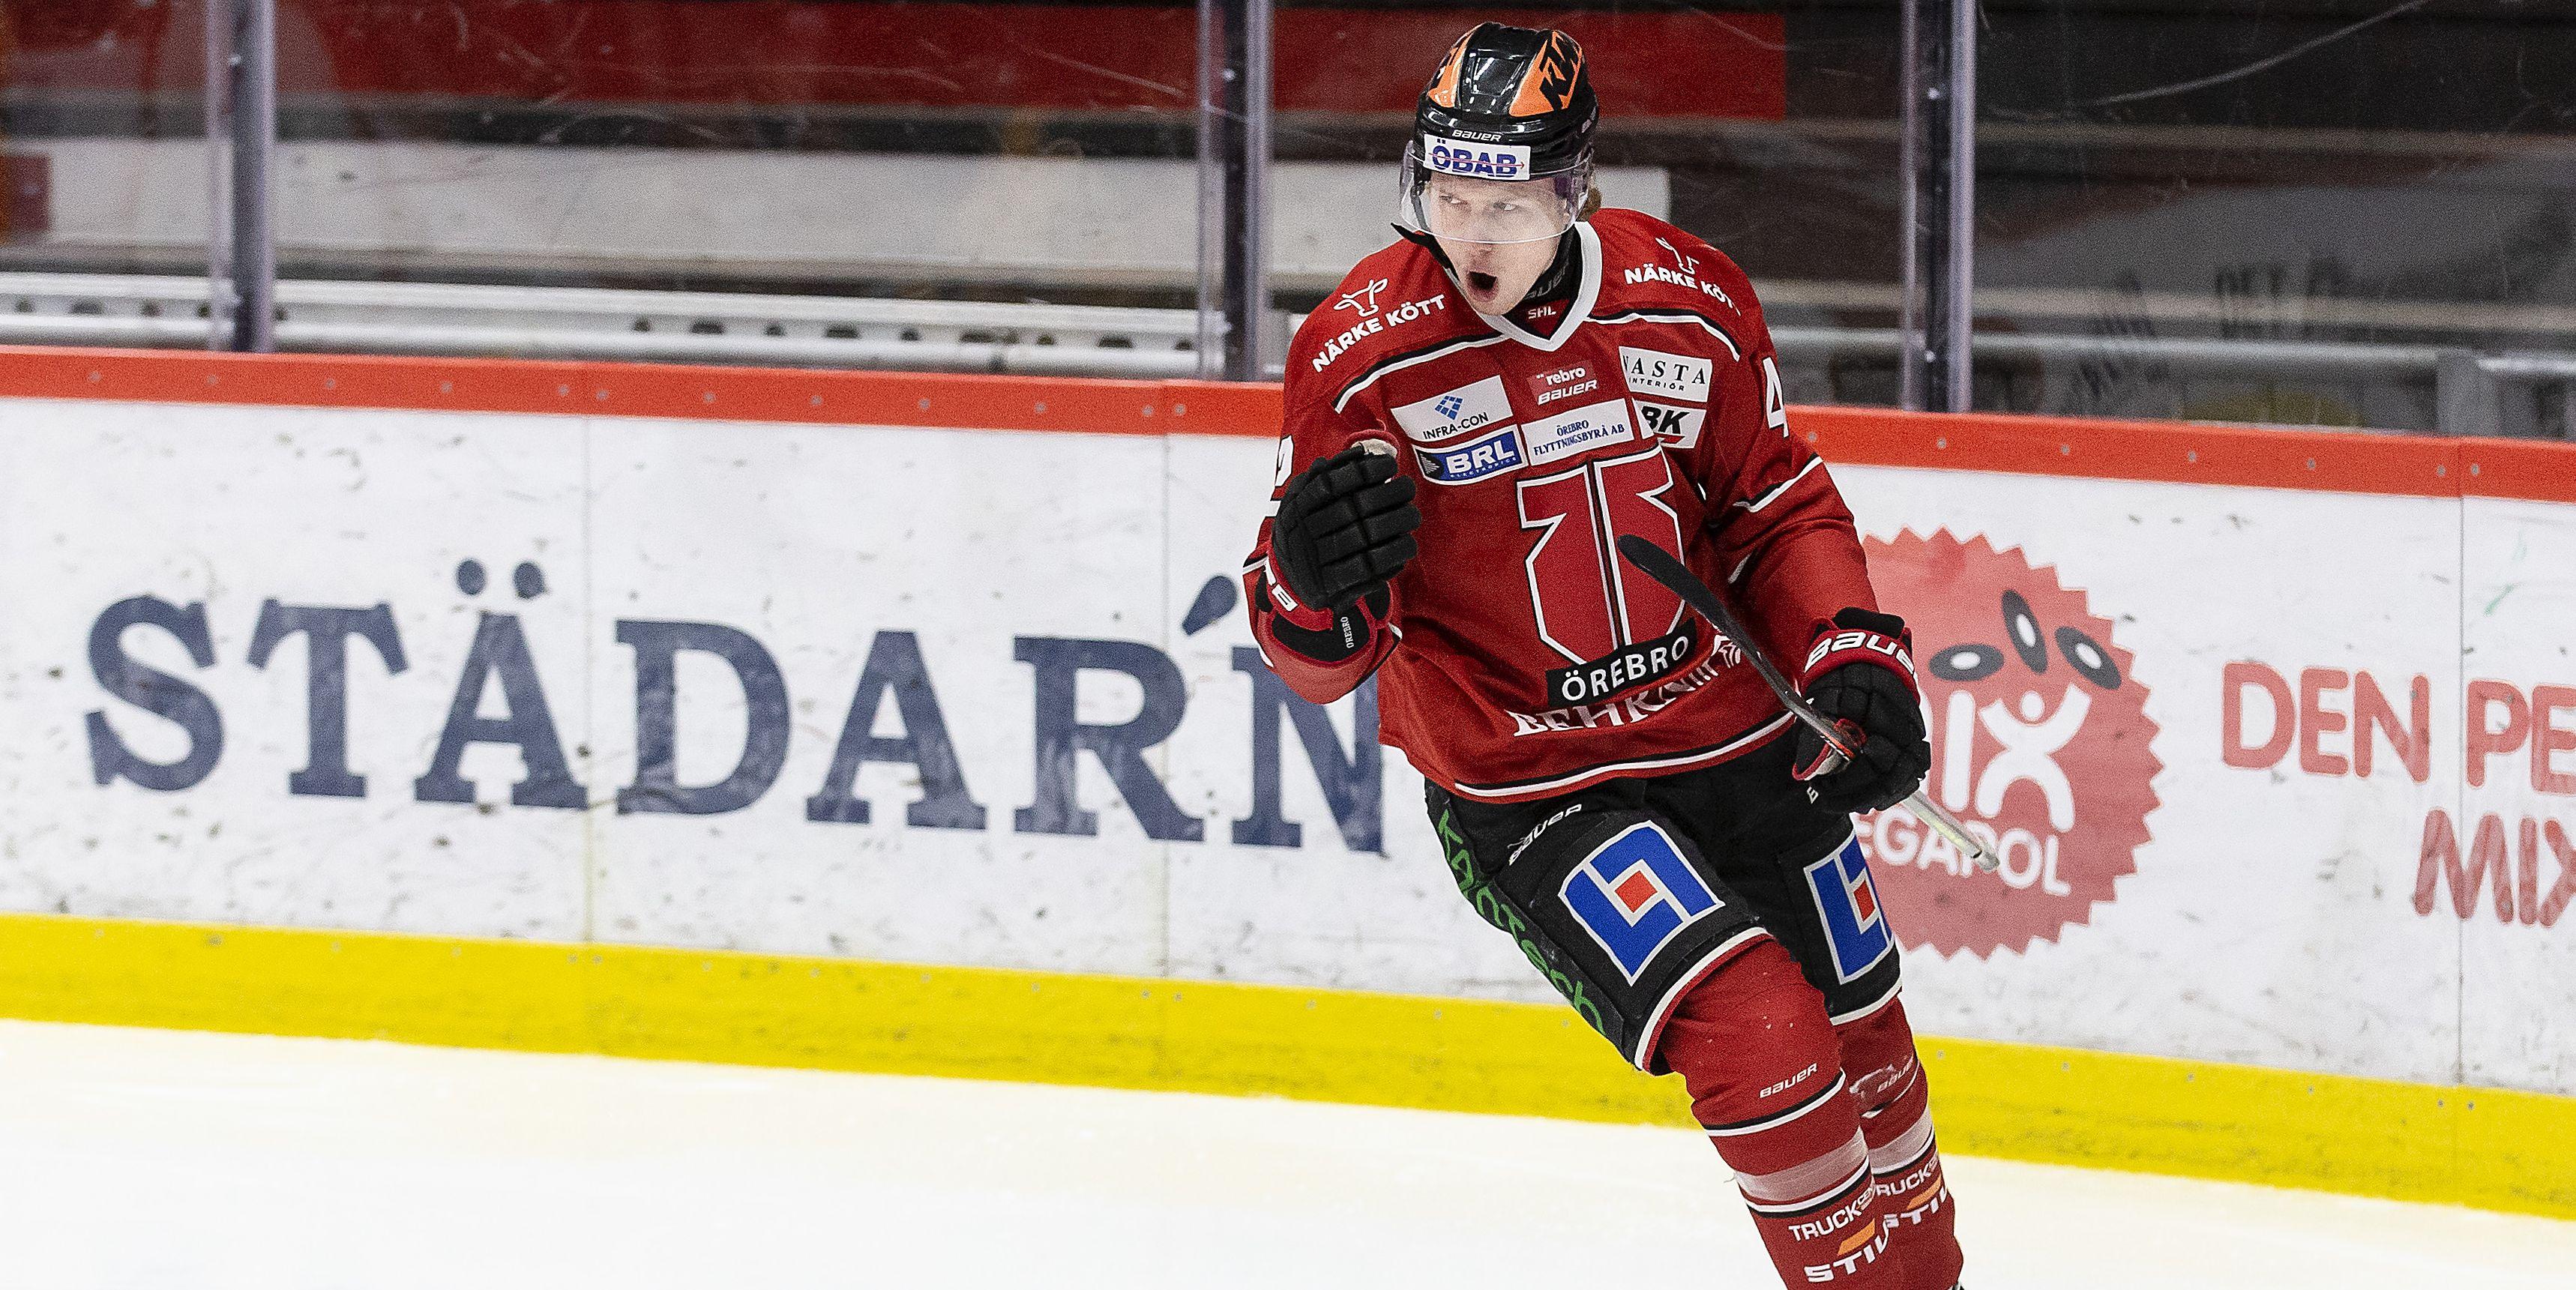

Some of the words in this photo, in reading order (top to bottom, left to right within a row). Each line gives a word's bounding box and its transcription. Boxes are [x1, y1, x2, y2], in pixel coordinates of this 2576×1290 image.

[1452, 129, 1502, 142] BAUER
[1432, 138, 1517, 177] ÖBAB
[1624, 263, 1697, 289] NÄRKE
[1700, 280, 1741, 316] KÖT
[1528, 306, 1556, 319] SHL
[1313, 318, 1382, 373] NÄRKE
[1386, 295, 1445, 326] KÖTT
[1538, 380, 1597, 406] BAUER
[1629, 377, 1685, 391] INTERIÖR
[1423, 412, 1488, 439] INFRA-CON
[1556, 420, 1589, 436] ÖREBRO
[1611, 424, 1625, 435] AB
[1446, 440, 1514, 474] BRL
[1562, 636, 1688, 701] ÖREBRO
[2221, 660, 2430, 783] DEN
[2467, 679, 2576, 796] PE
[1760, 1063, 1817, 1099] BAUER
